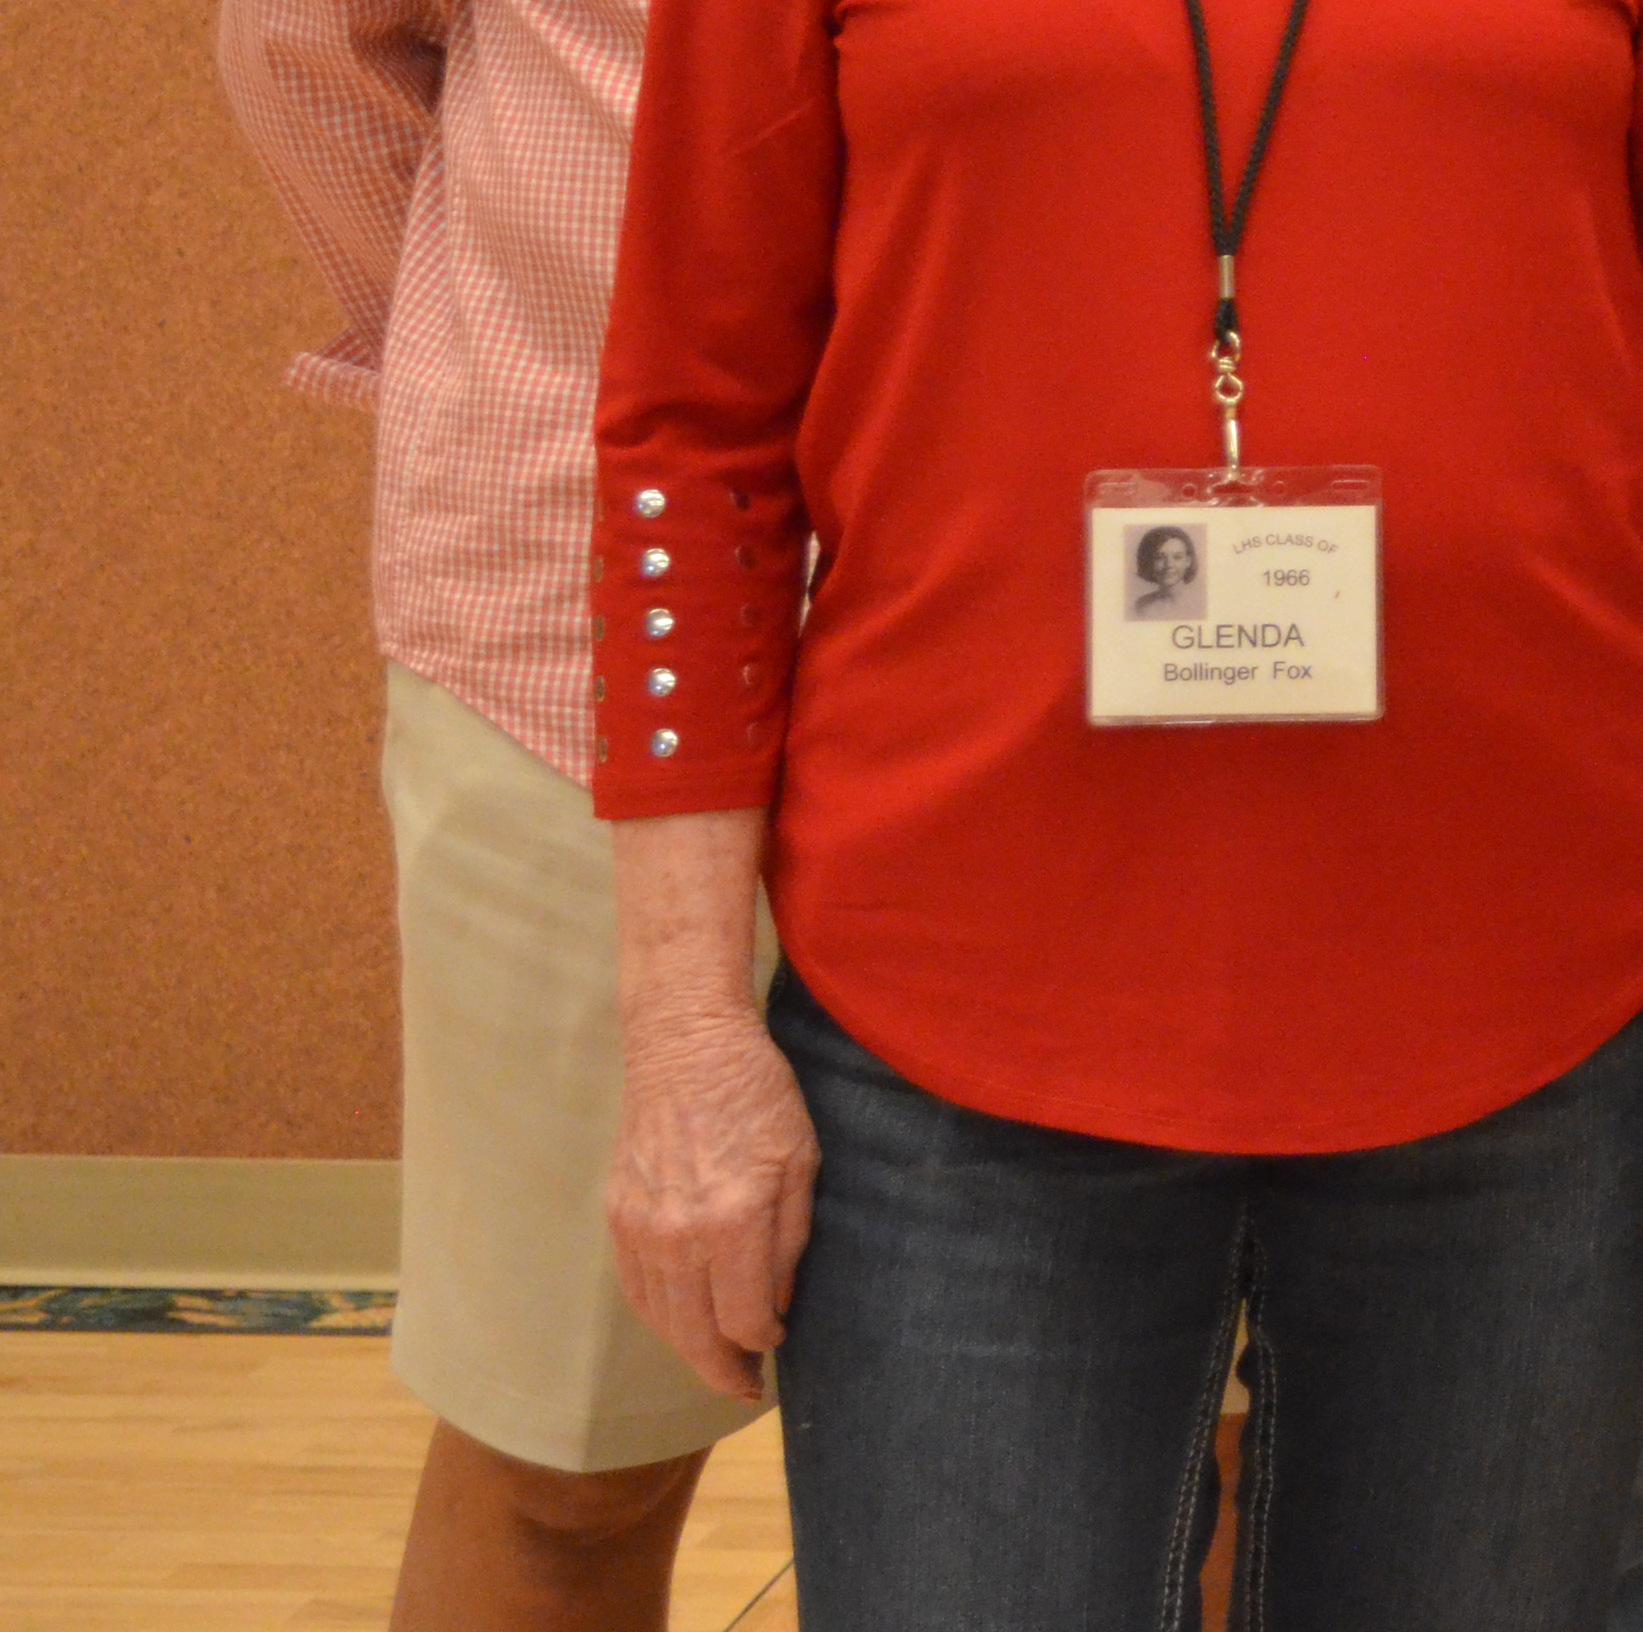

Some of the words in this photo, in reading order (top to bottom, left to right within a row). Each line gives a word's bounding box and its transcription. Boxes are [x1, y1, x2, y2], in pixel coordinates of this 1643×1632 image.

[1232, 536, 1262, 555] LHS
[1264, 533, 1314, 549] CLASS
[1317, 539, 1340, 556] OF
[1262, 568, 1311, 587] 1966
[1171, 623, 1306, 649] GLENDA
[1164, 663, 1258, 686] Bollinger
[1273, 661, 1313, 680] Fox
